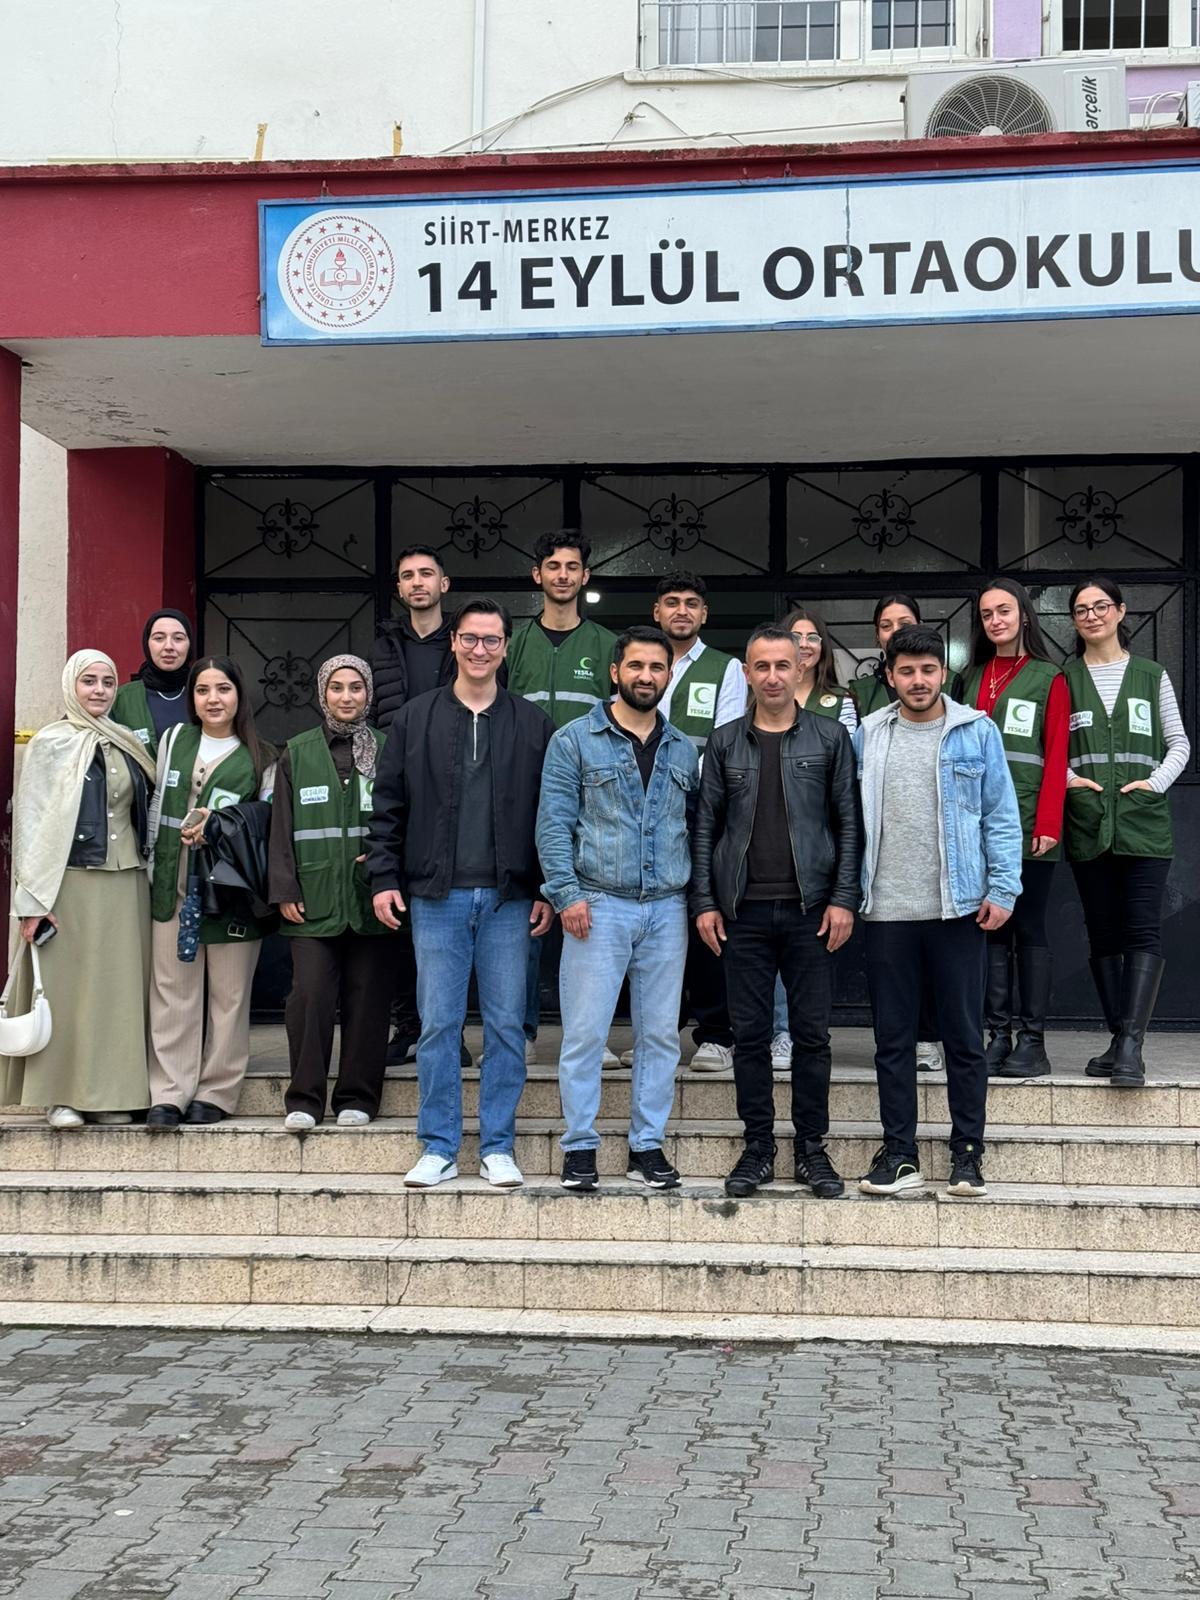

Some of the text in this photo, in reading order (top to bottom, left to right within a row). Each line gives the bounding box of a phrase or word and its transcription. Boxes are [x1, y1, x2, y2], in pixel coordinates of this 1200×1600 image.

[1082, 76, 1101, 129] arçelik
[424, 215, 610, 246] SİİRT-MERKEZ
[418, 261, 498, 312] 14
[521, 238, 739, 310] EYLÜL
